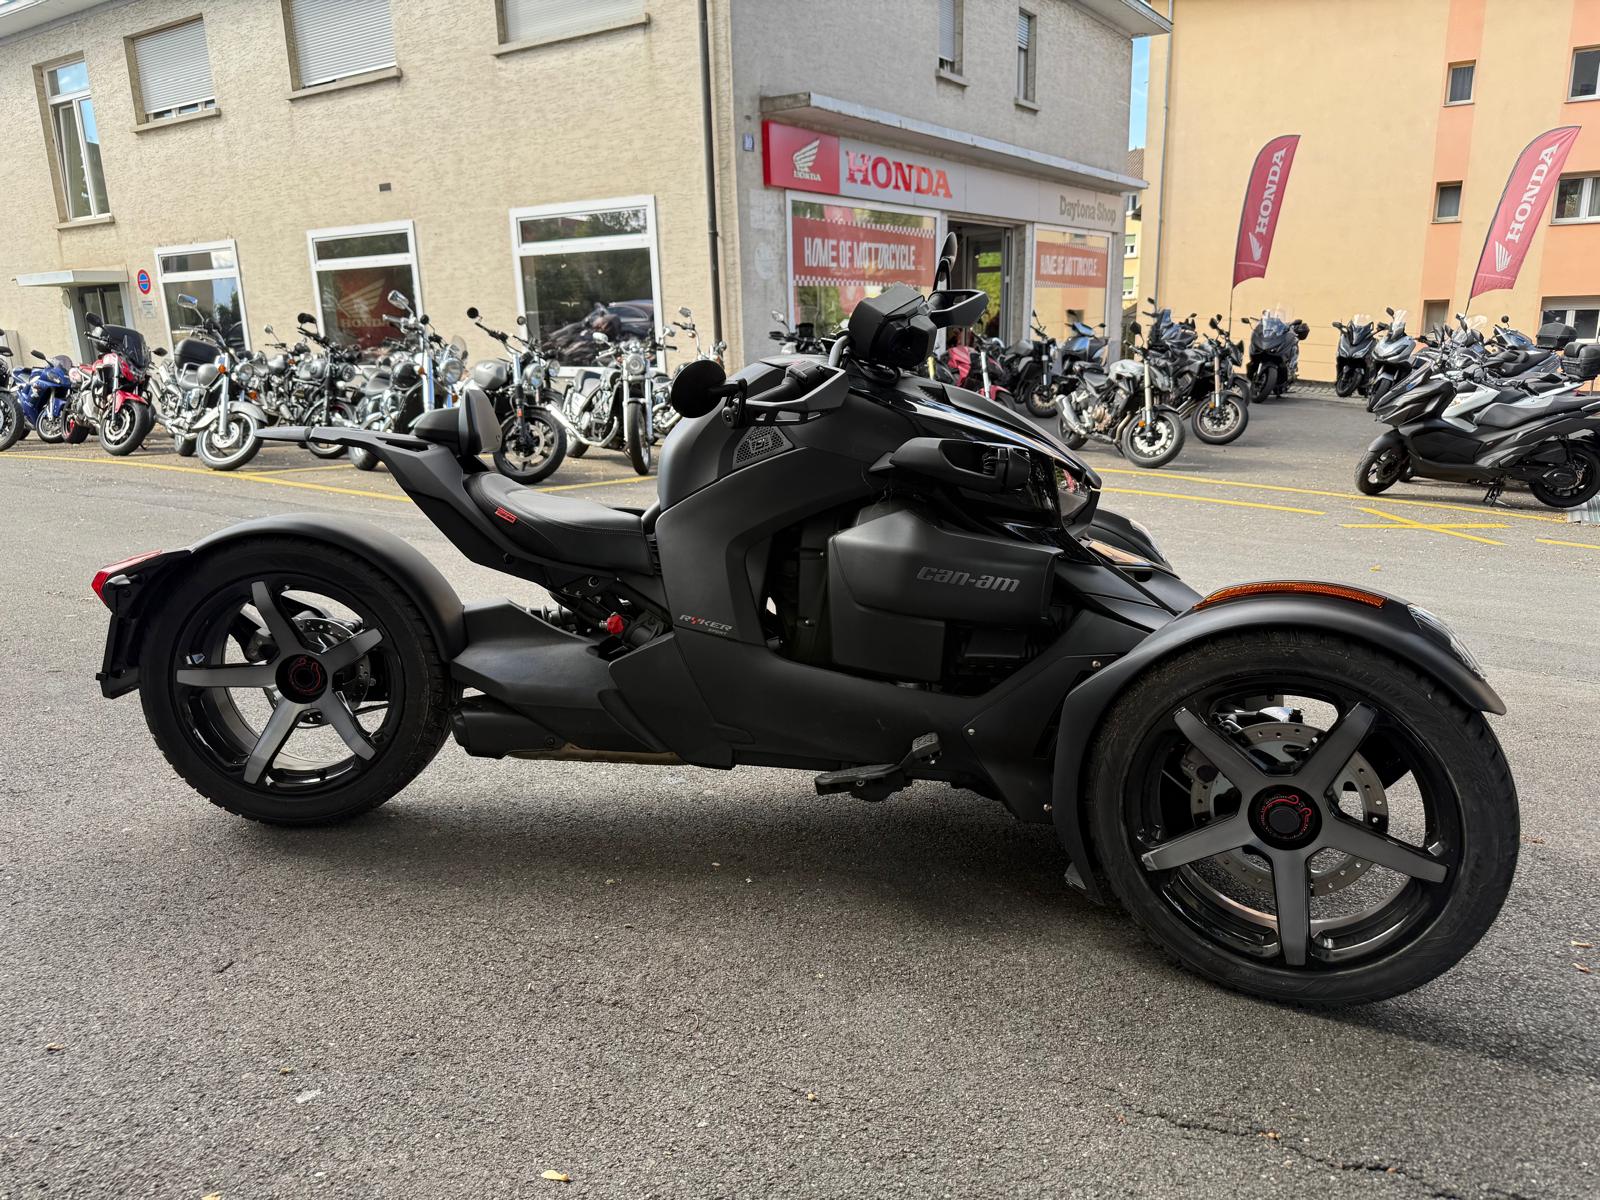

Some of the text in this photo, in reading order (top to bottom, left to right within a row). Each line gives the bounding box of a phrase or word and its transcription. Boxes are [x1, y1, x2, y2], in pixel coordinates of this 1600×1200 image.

[793, 170, 822, 182] HONDA
[845, 150, 953, 199] HONDA
[1255, 147, 1287, 235] HONDA
[1505, 143, 1559, 243] HONDA
[1059, 194, 1117, 226] Daytona Shop
[839, 239, 852, 269] OF
[916, 566, 1021, 593] can-am
